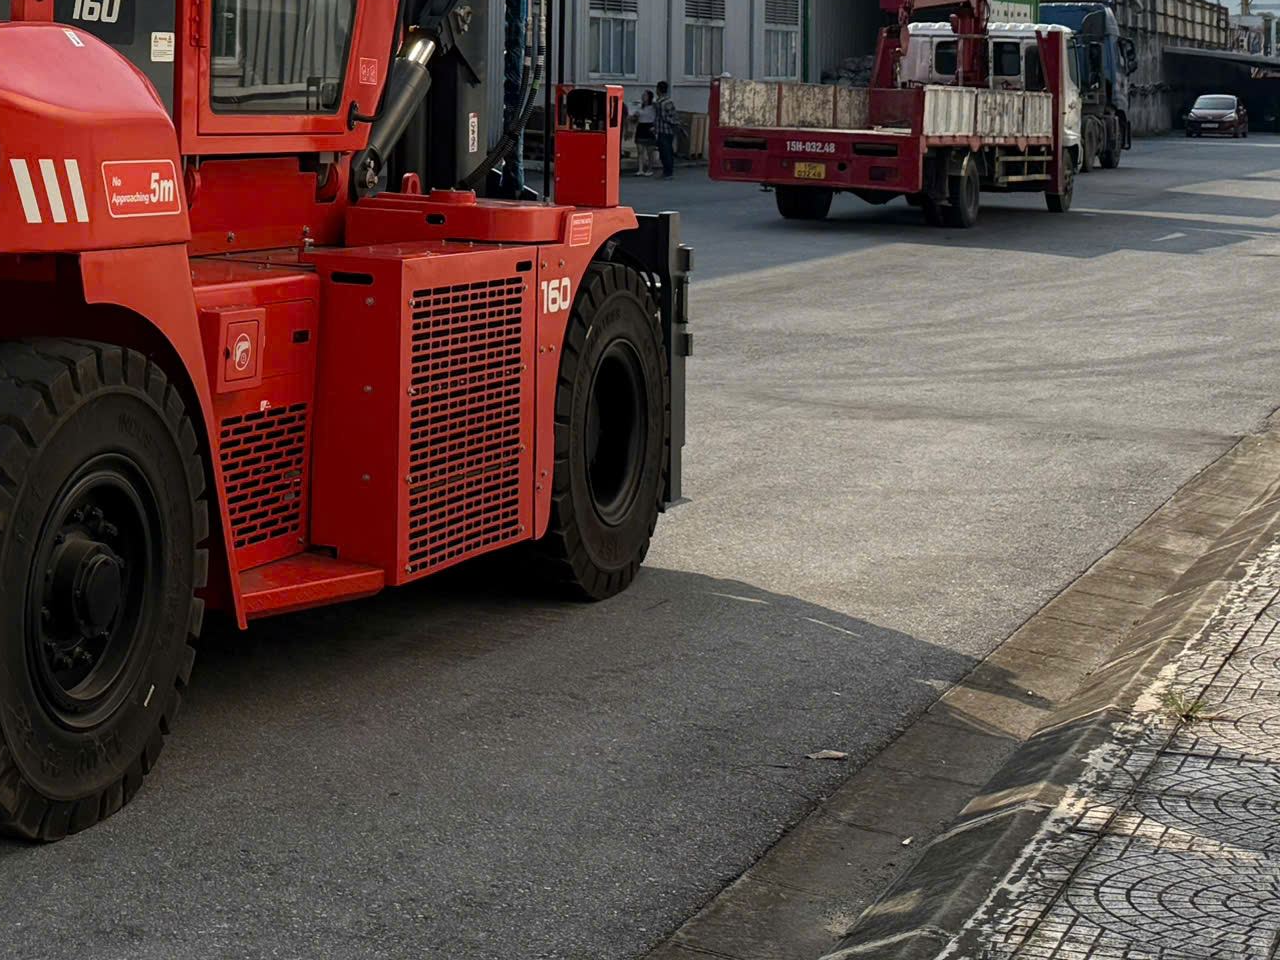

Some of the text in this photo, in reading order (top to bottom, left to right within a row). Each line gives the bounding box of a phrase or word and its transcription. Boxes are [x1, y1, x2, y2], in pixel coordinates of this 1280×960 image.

[786, 140, 836, 153] 15H-032.48
[111, 172, 175, 206] Approaching 5m
[112, 176, 122, 187] No
[541, 276, 571, 314] 160
